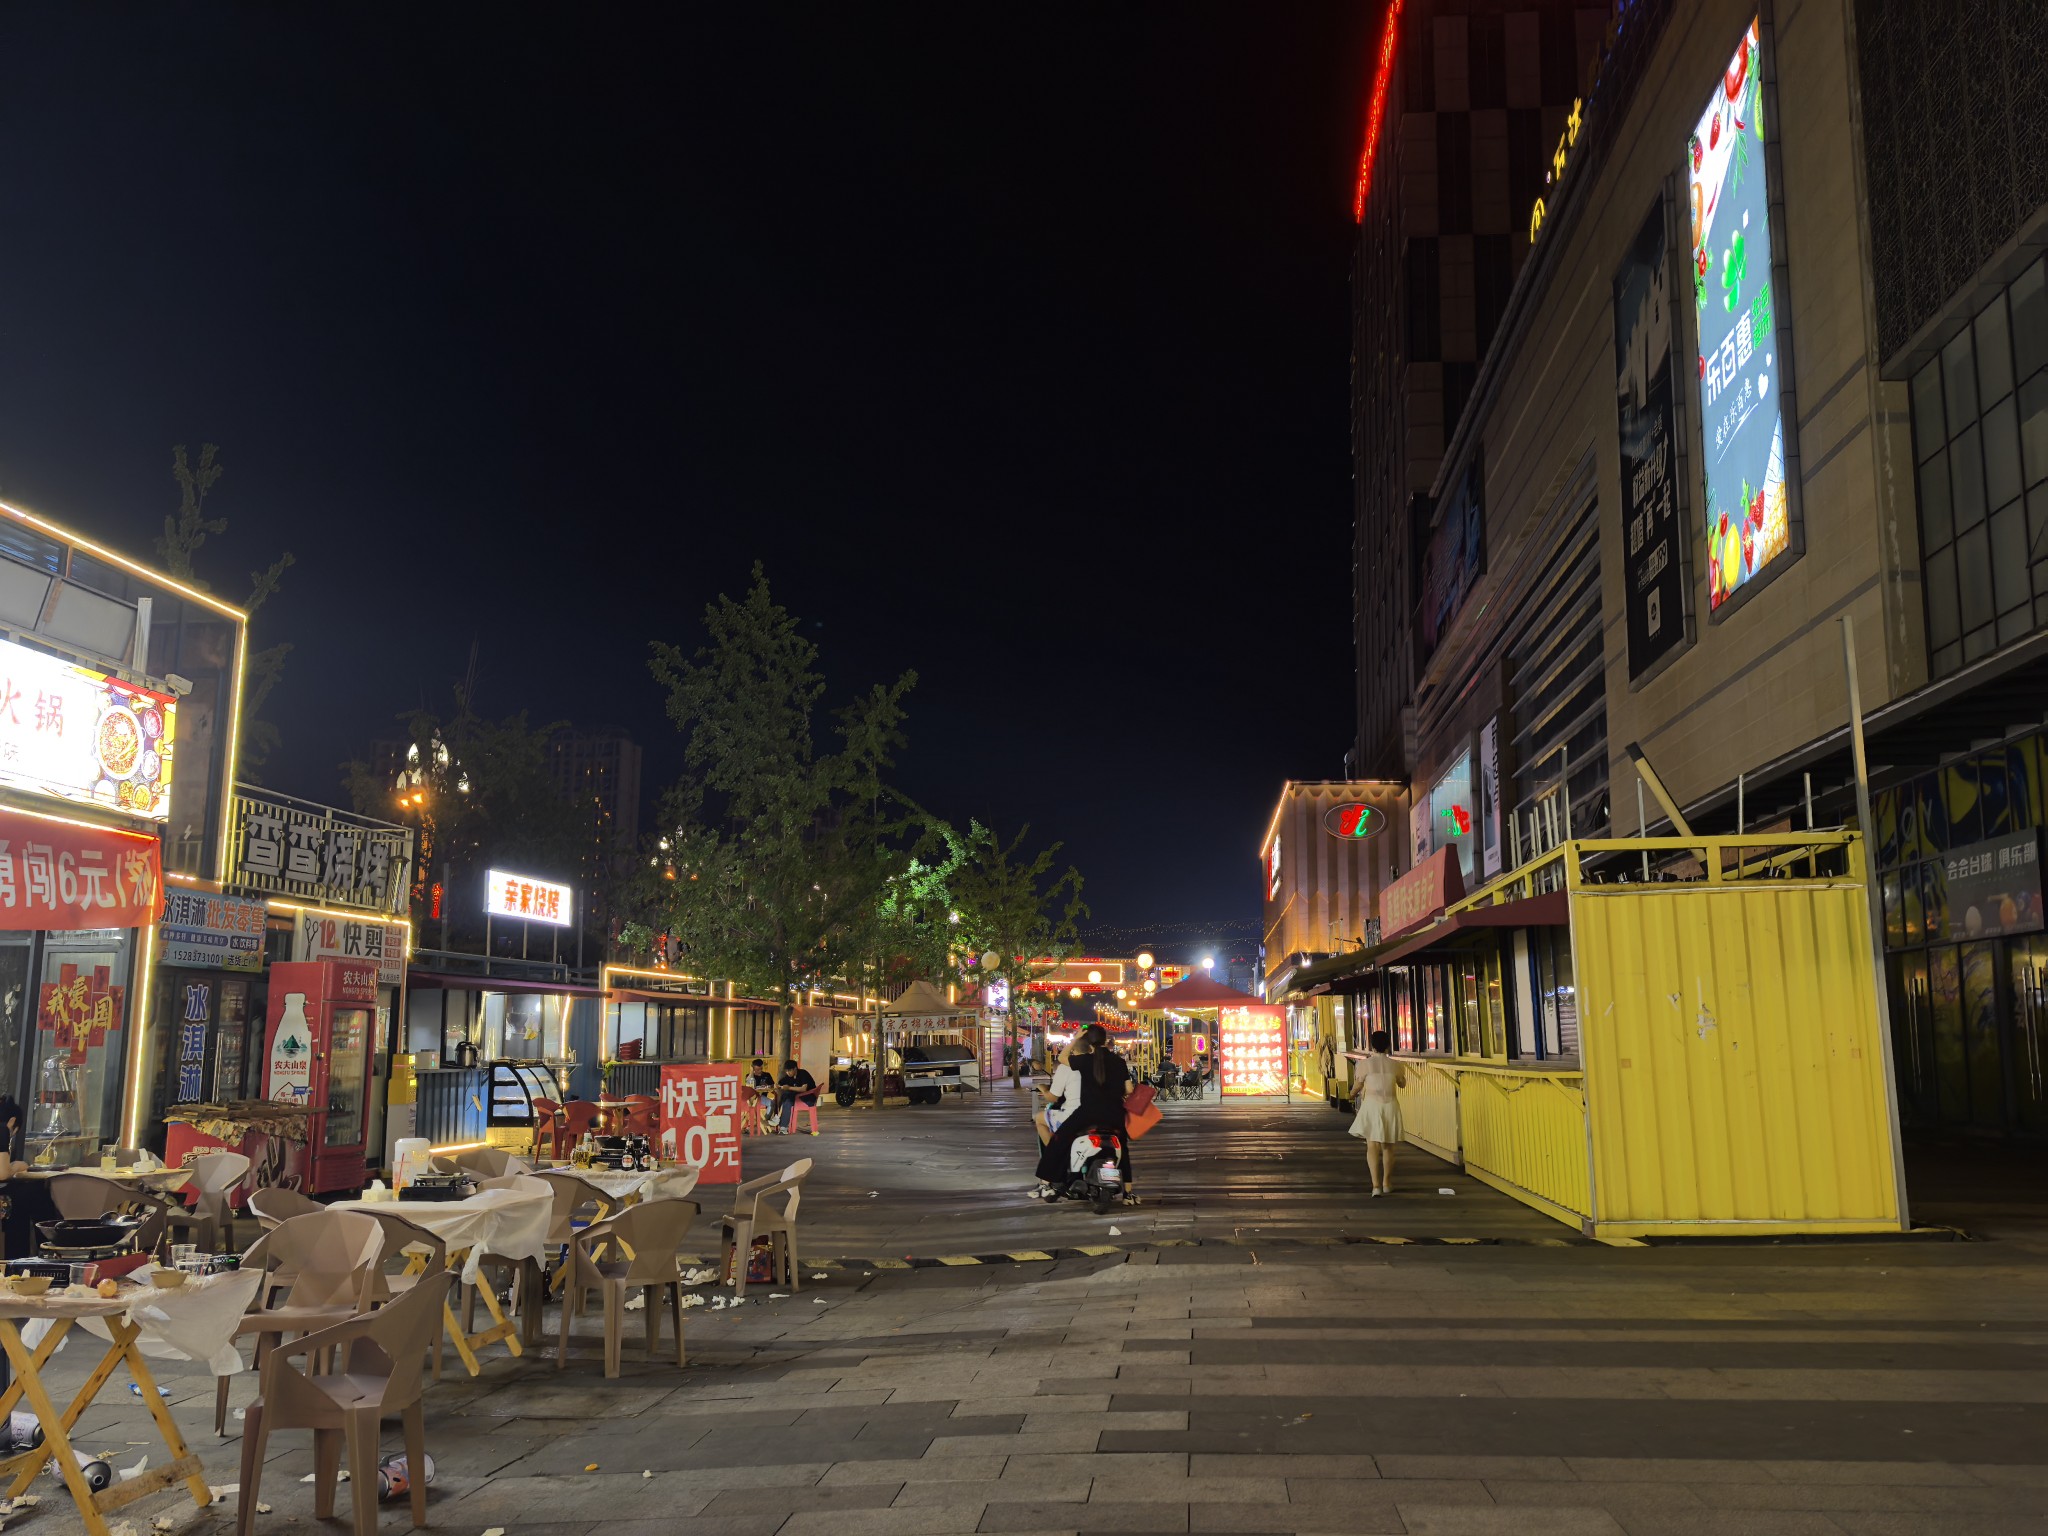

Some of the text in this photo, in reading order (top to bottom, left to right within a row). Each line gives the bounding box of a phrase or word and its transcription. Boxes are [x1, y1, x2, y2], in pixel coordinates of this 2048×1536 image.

[1752, 282, 1770, 323] 生活
[1706, 309, 1753, 407] 乐百惠
[242, 812, 391, 900] 查查烧烤
[161, 892, 265, 935] 冰淇淋批发零售
[343, 920, 384, 958] 快剪
[343, 970, 375, 986] 农夫山泉
[178, 984, 208, 1102] 冰淇淋
[274, 1060, 307, 1070] 农夫山泉
[662, 1075, 738, 1118] 快剪
[661, 1125, 739, 1169] 10元
